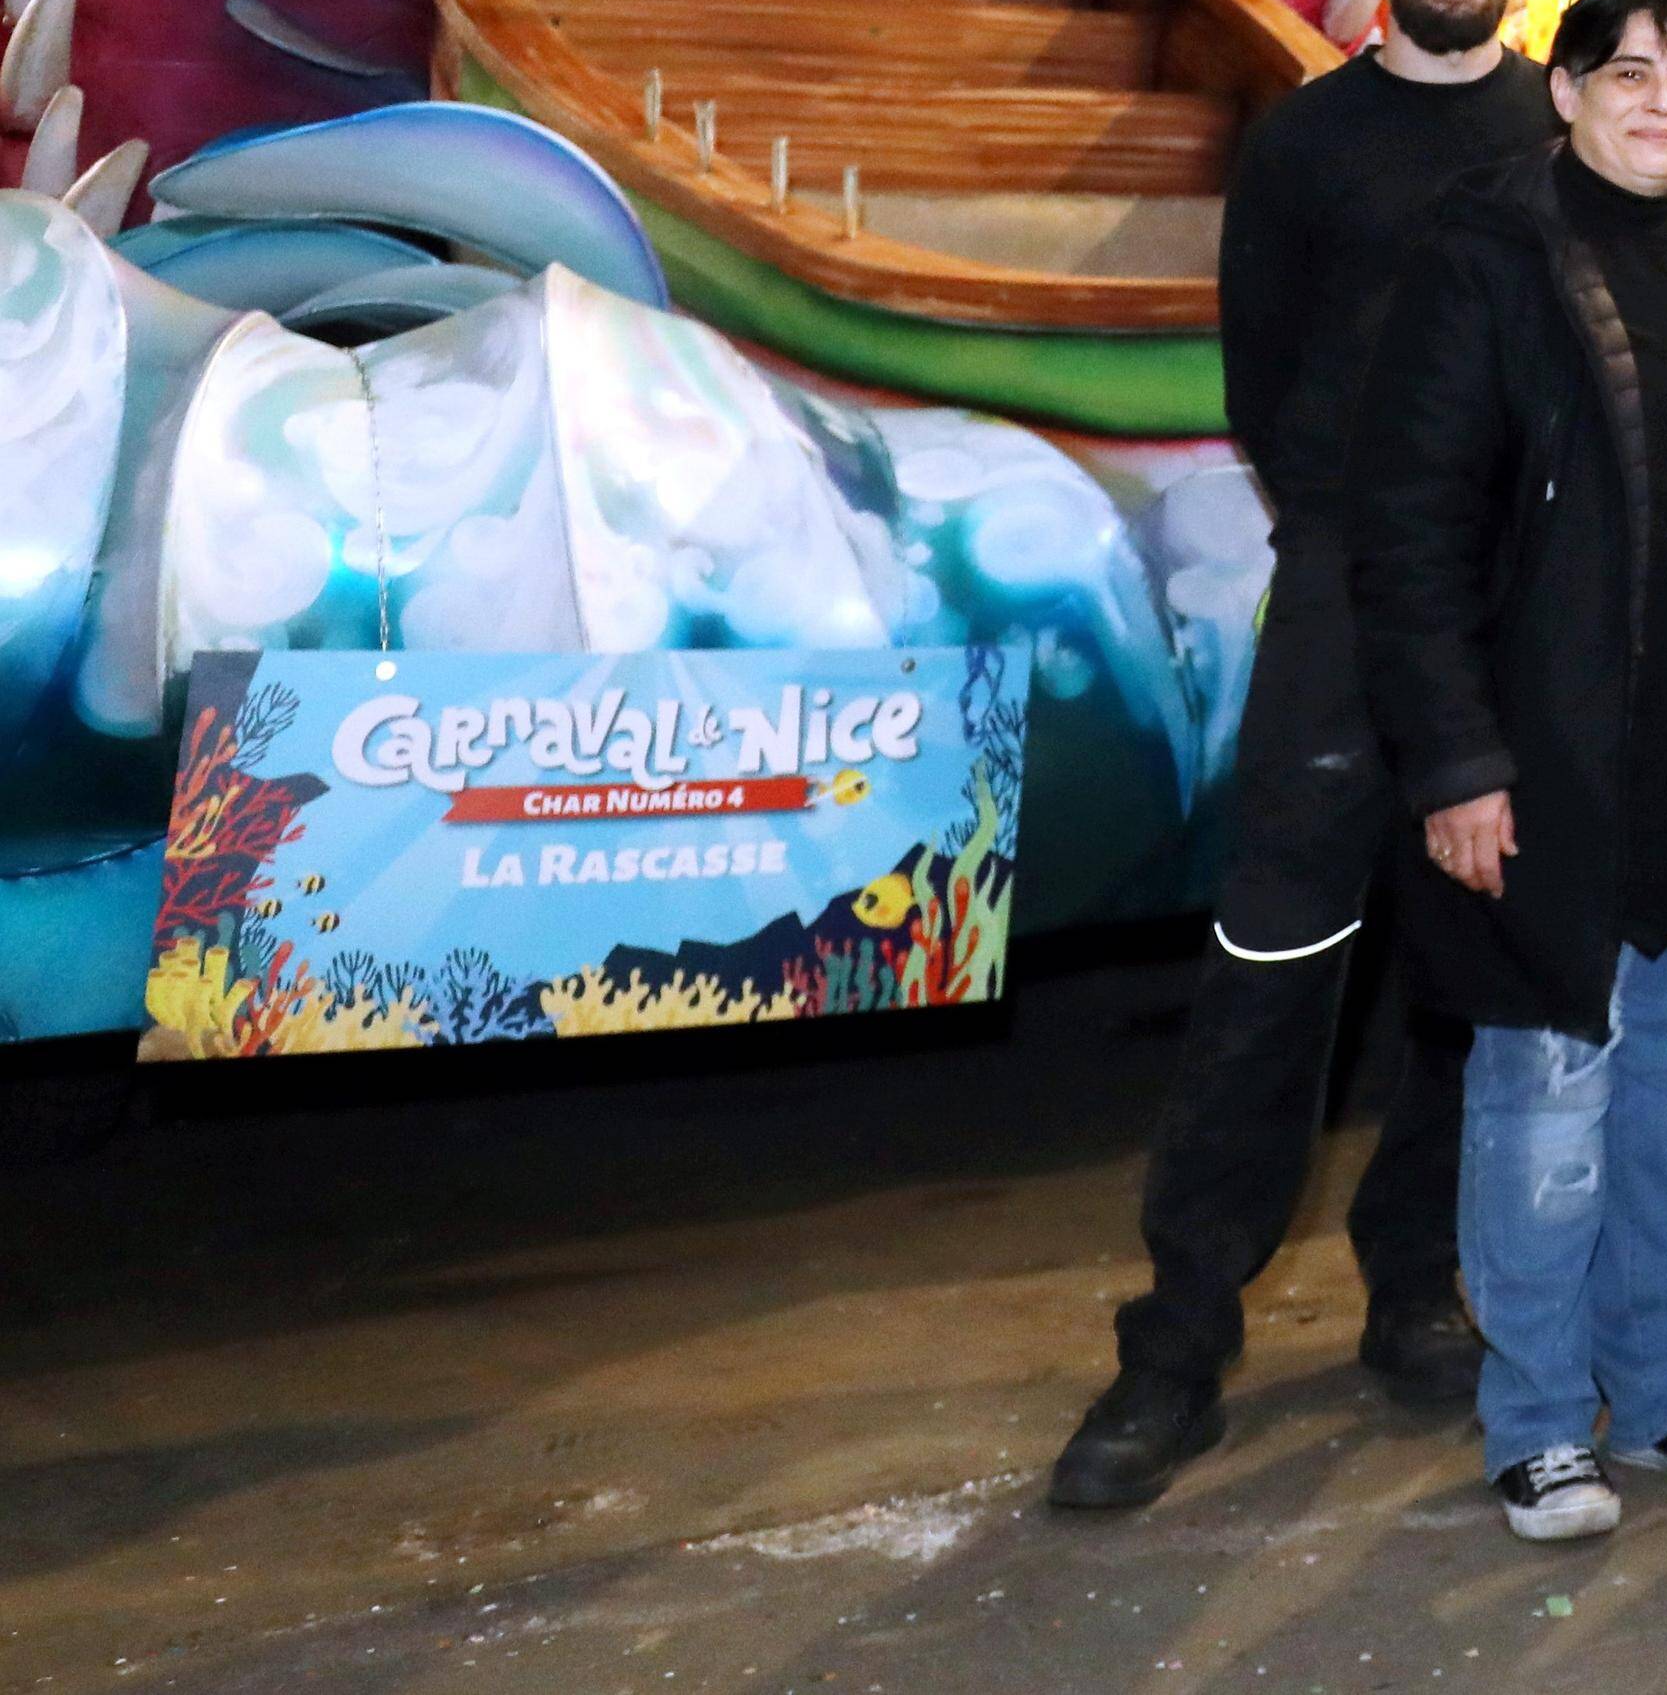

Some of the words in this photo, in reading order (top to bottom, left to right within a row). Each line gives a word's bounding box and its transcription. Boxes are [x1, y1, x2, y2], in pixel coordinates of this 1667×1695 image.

[688, 704, 723, 747] de
[728, 684, 922, 775] Nice
[727, 787, 745, 808] 4
